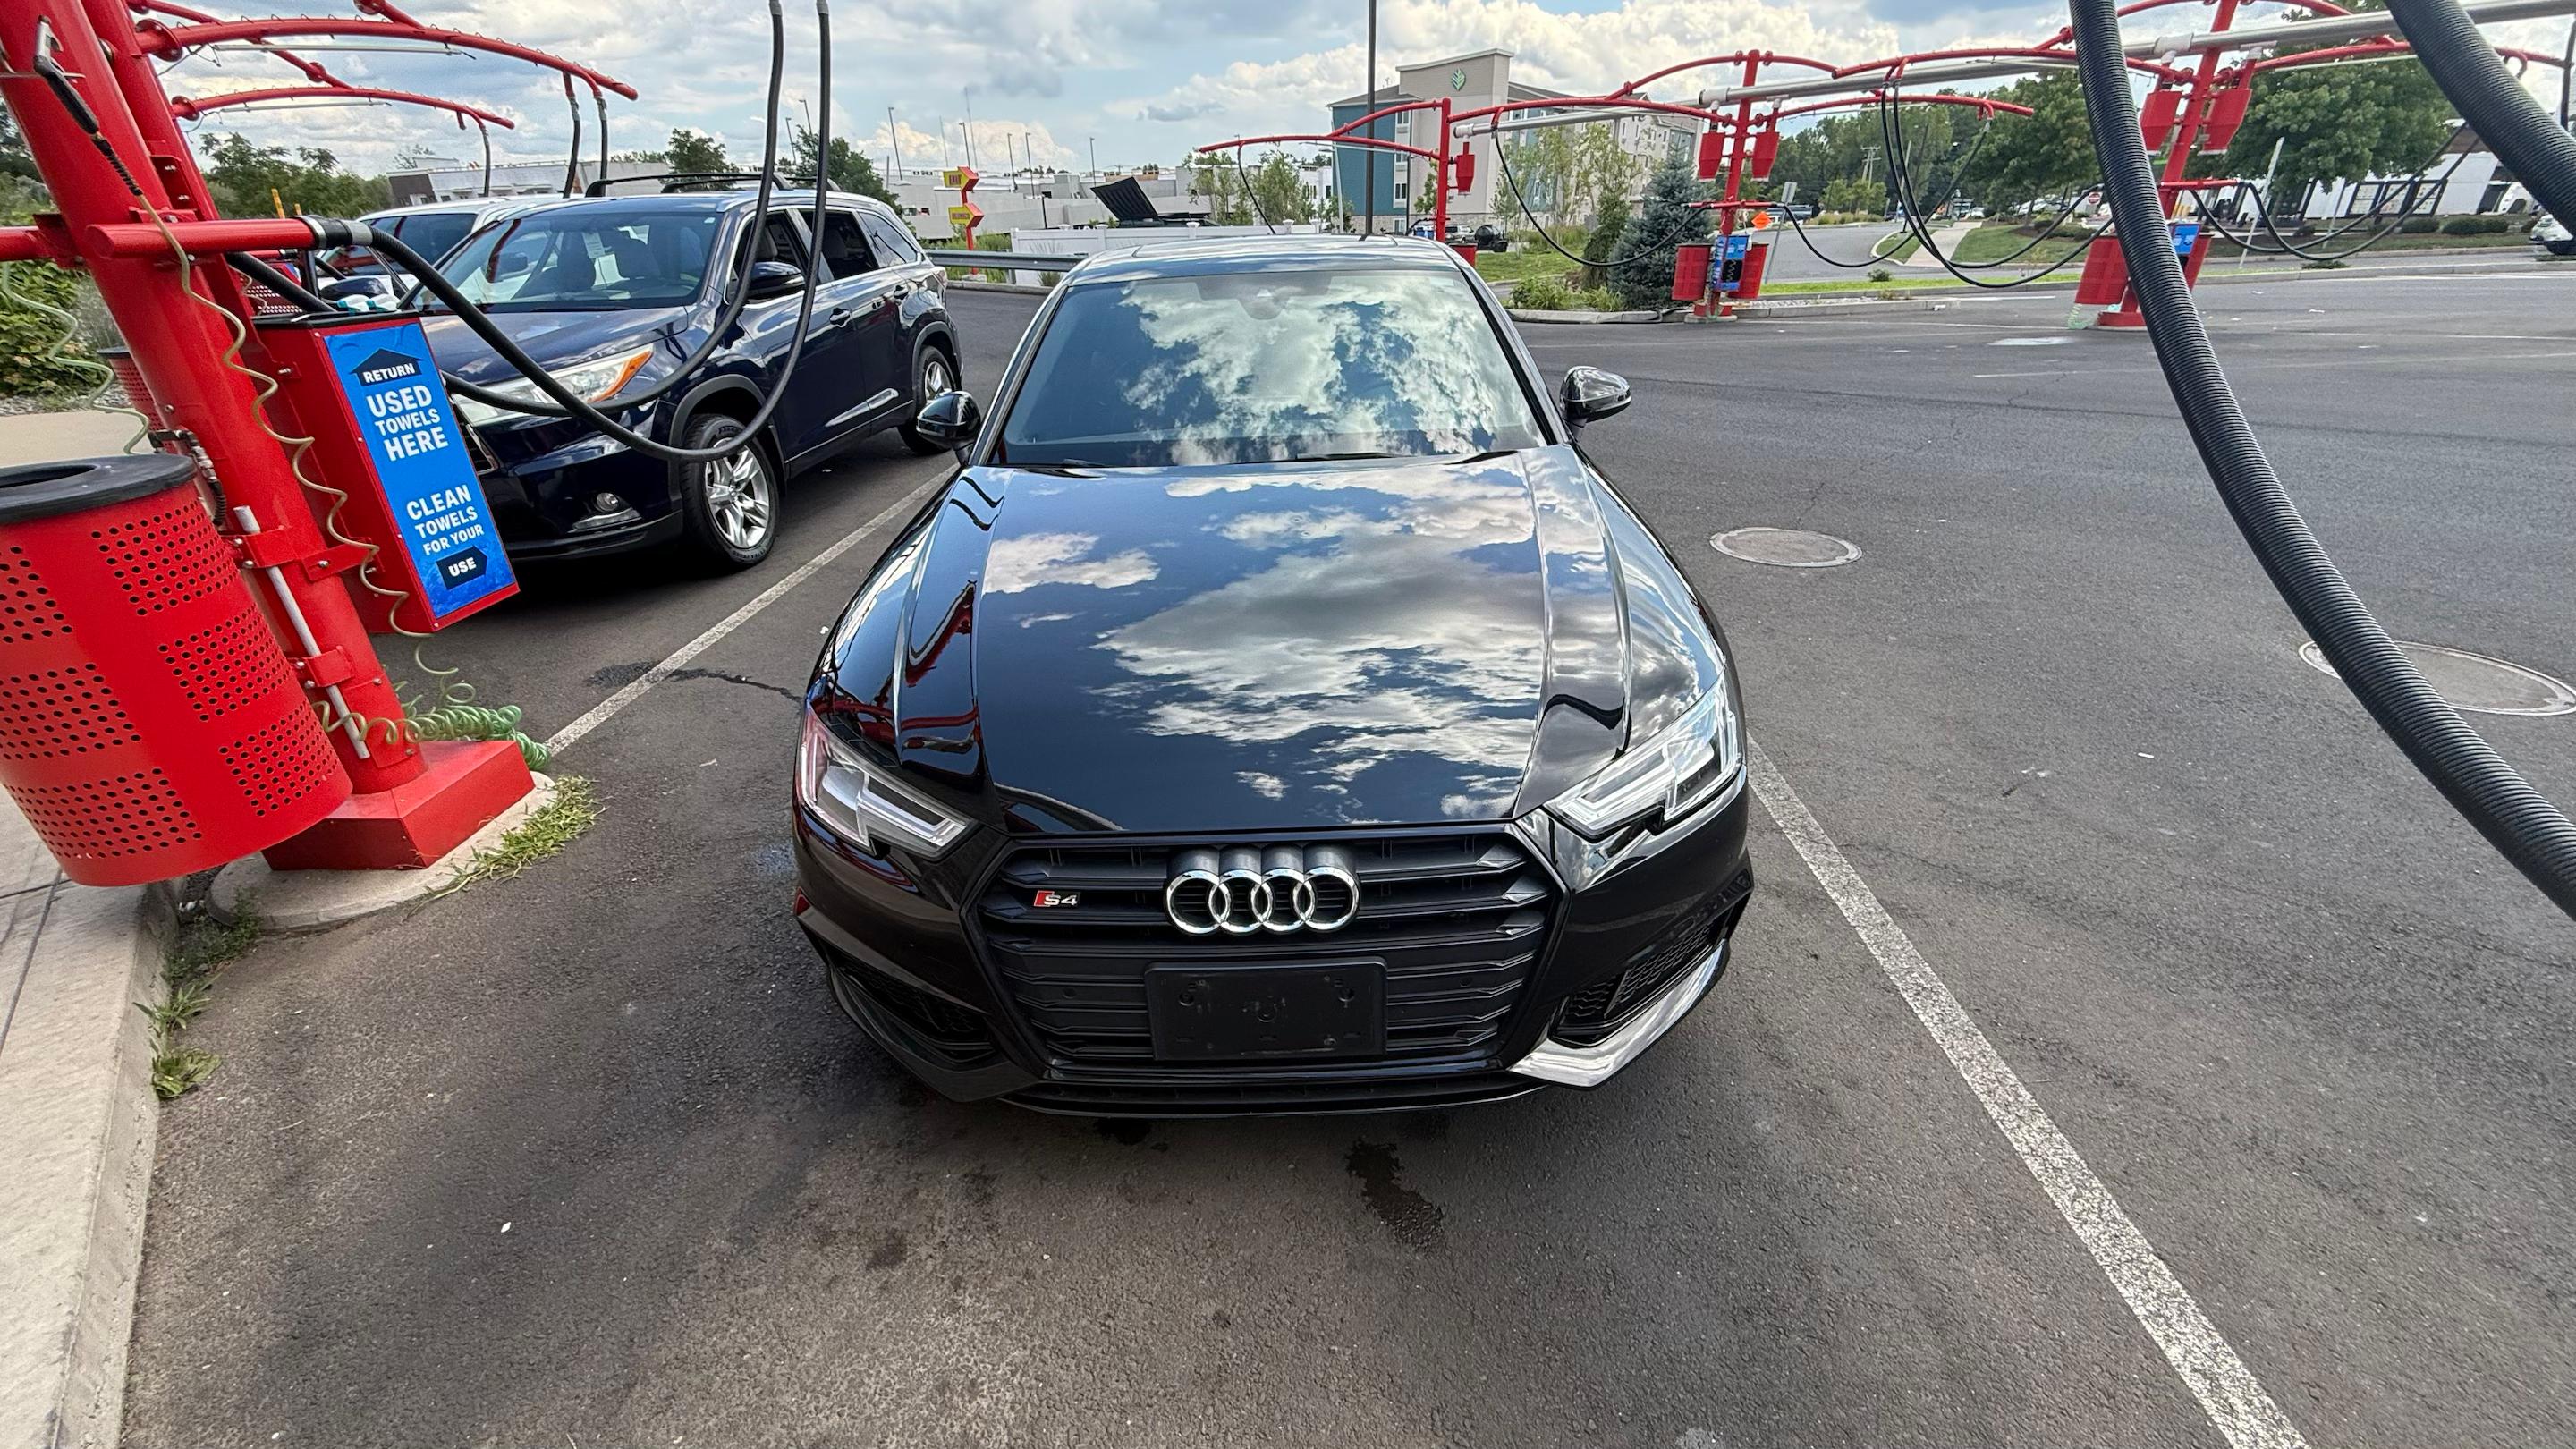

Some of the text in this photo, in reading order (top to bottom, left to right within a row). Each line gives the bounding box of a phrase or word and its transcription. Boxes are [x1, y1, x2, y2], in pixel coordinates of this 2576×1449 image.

[362, 362, 416, 384] RETURN
[366, 385, 433, 418] USED
[374, 408, 441, 436] TOWELS
[383, 426, 449, 462] HERE
[406, 484, 472, 521] CLEAN
[414, 505, 479, 538] TOWELS
[422, 524, 485, 556] FOR YOUR
[448, 557, 477, 578] USE
[1043, 894, 1079, 907] S4
